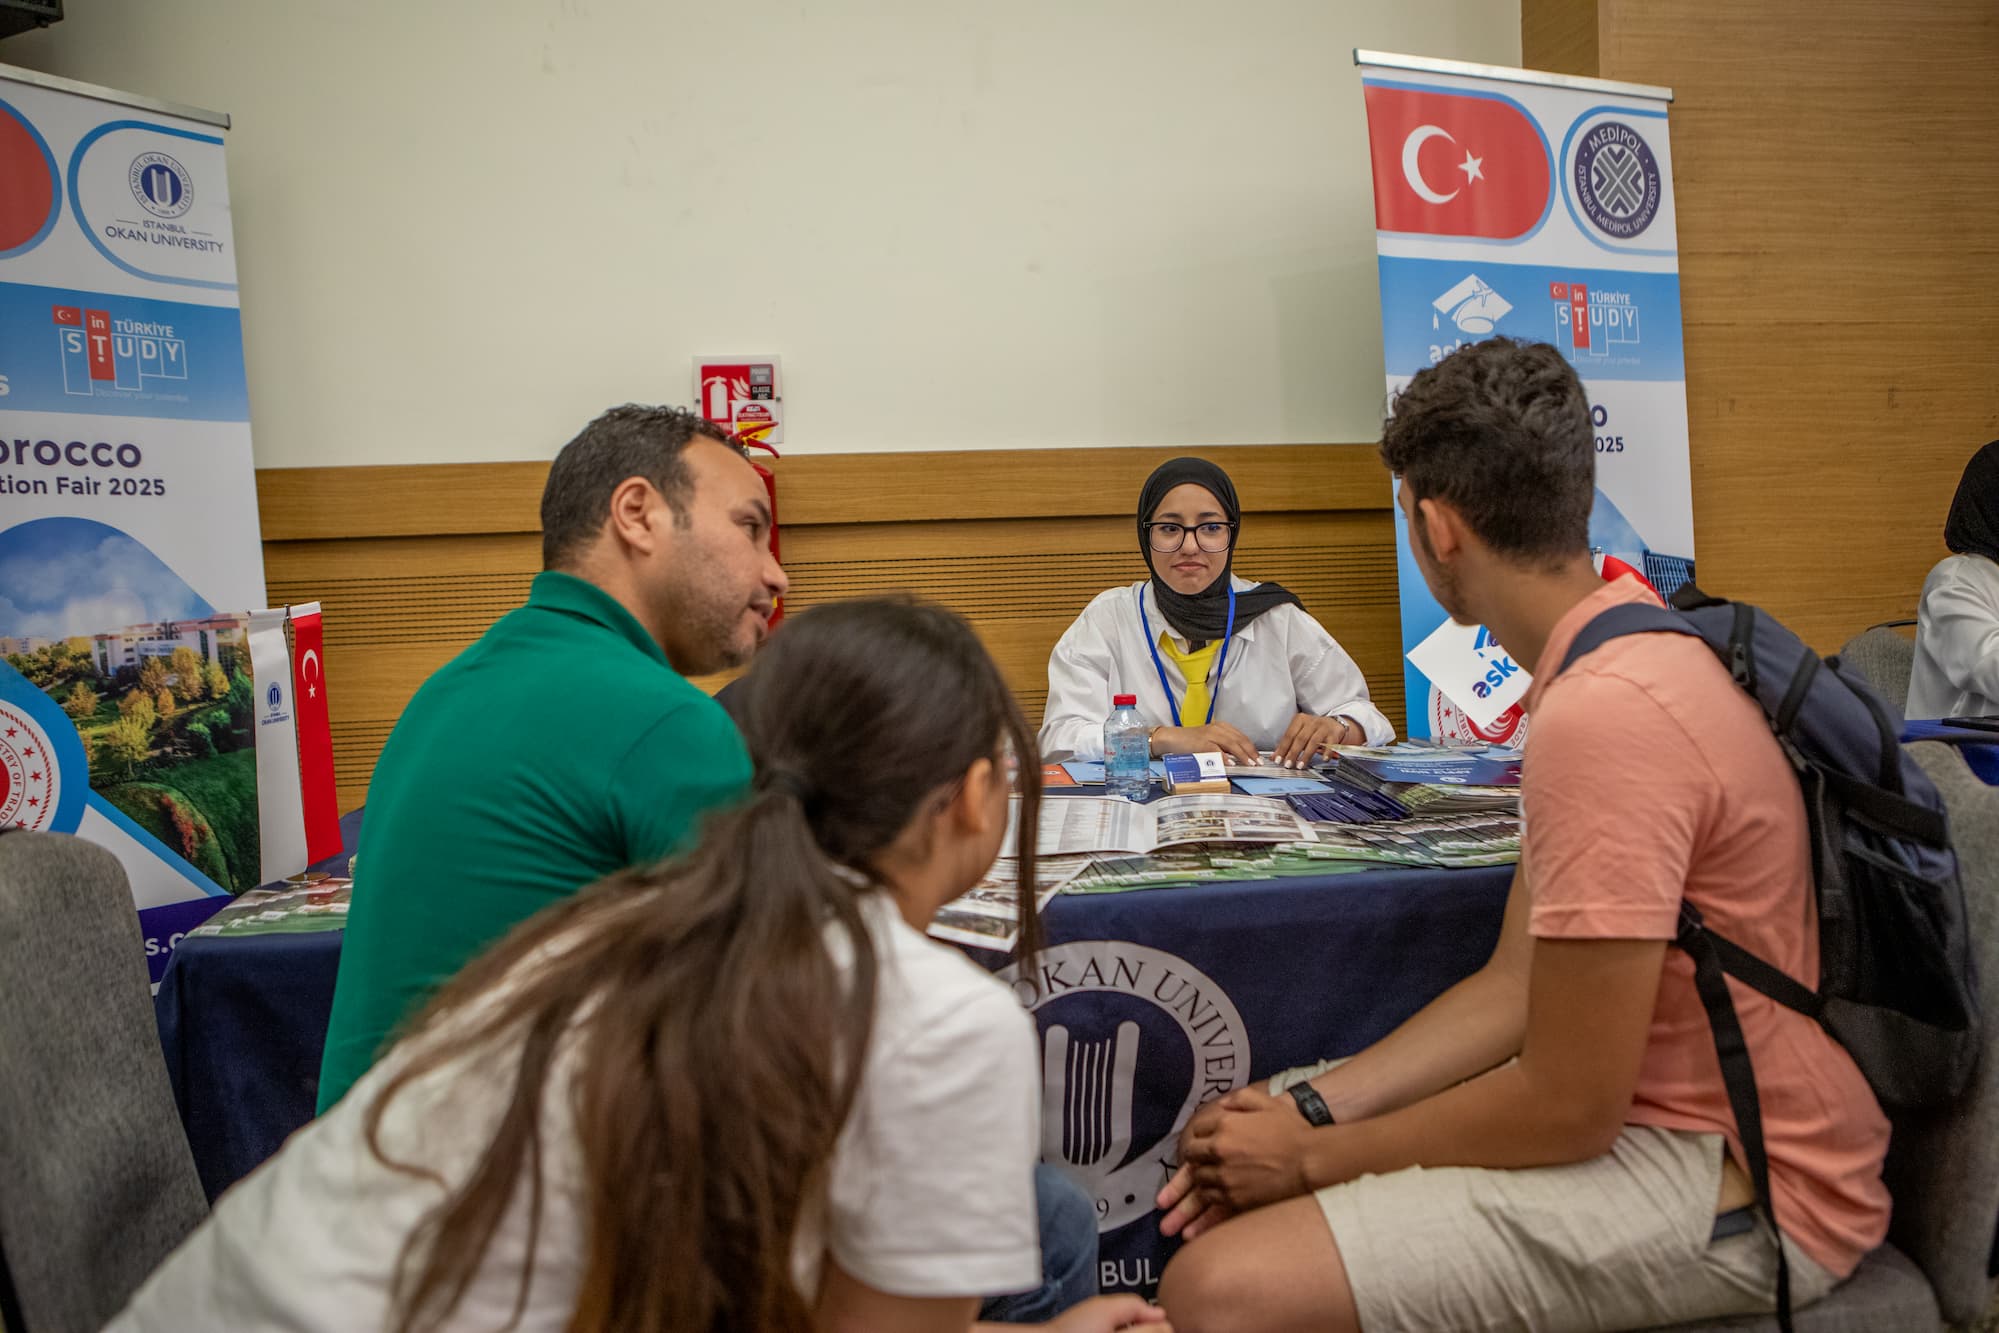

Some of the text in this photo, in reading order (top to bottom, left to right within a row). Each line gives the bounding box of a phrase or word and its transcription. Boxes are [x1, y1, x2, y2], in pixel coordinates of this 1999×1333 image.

[105, 226, 224, 253] OKAN UNIVERSITY
[1574, 289, 1584, 302] in
[1590, 291, 1631, 305] TÜRKİYE
[91, 315, 105, 329] in
[114, 319, 174, 338] TÜRKİYE
[1595, 436, 1624, 452] 025
[56, 477, 101, 495] Fair
[109, 478, 165, 496] 2025
[1472, 656, 1519, 699] ask
[12, 773, 22, 787] OF
[0, 792, 20, 820] TRAD
[1012, 957, 1145, 1009] OKAN
